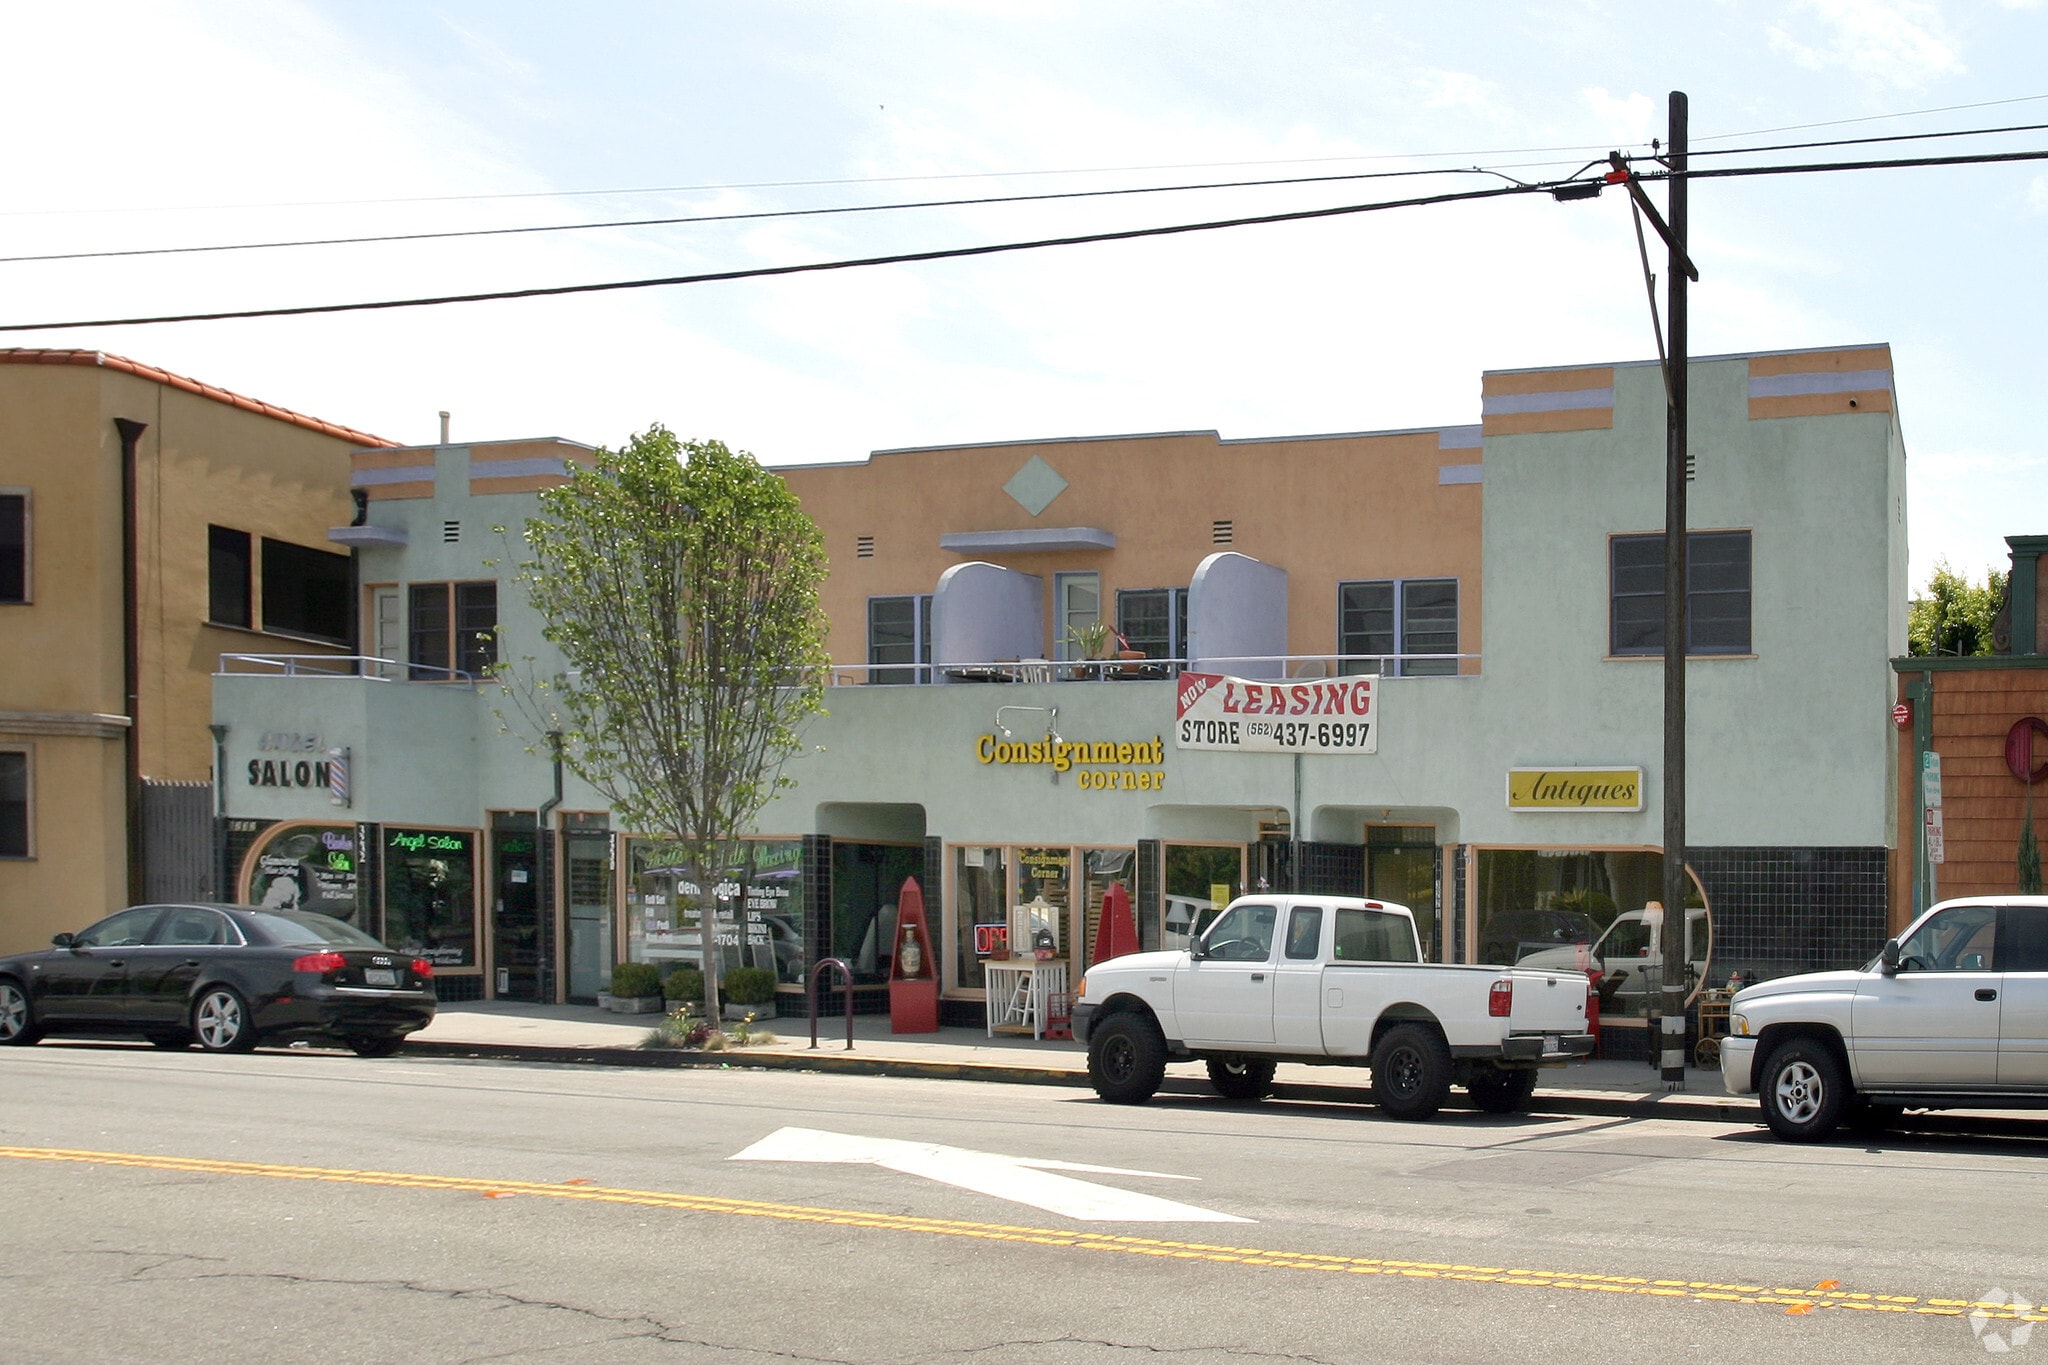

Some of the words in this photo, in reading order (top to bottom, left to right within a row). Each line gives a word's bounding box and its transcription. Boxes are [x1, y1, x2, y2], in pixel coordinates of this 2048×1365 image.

[1180, 677, 1208, 709] NOW
[1222, 681, 1371, 716] LEASING
[1181, 719, 1240, 744] STORE
[976, 734, 1165, 772] Consignment
[248, 759, 331, 788] SALON
[1077, 770, 1165, 790] corner
[1512, 772, 1635, 806] Antiques
[390, 832, 425, 851] Angel
[427, 836, 463, 850] Salon
[1020, 855, 1071, 867] Consignment
[1031, 867, 1059, 878] Corner
